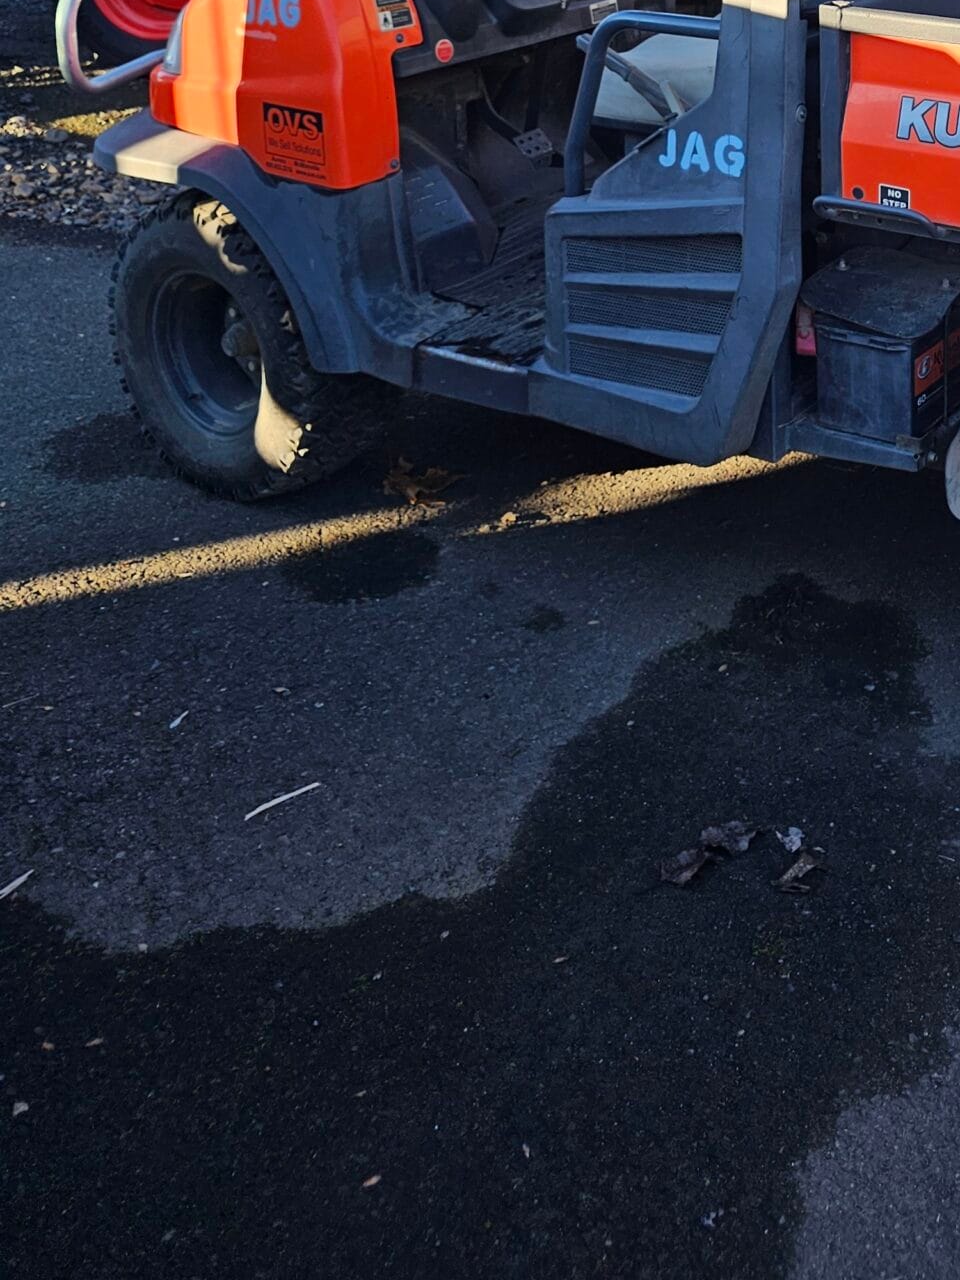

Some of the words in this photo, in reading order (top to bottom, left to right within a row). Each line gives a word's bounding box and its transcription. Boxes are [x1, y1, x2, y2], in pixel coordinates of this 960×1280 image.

[267, 107, 320, 140] OVS
[659, 128, 745, 177] JAG
[882, 198, 907, 209] STEP
[887, 188, 902, 199] NO
